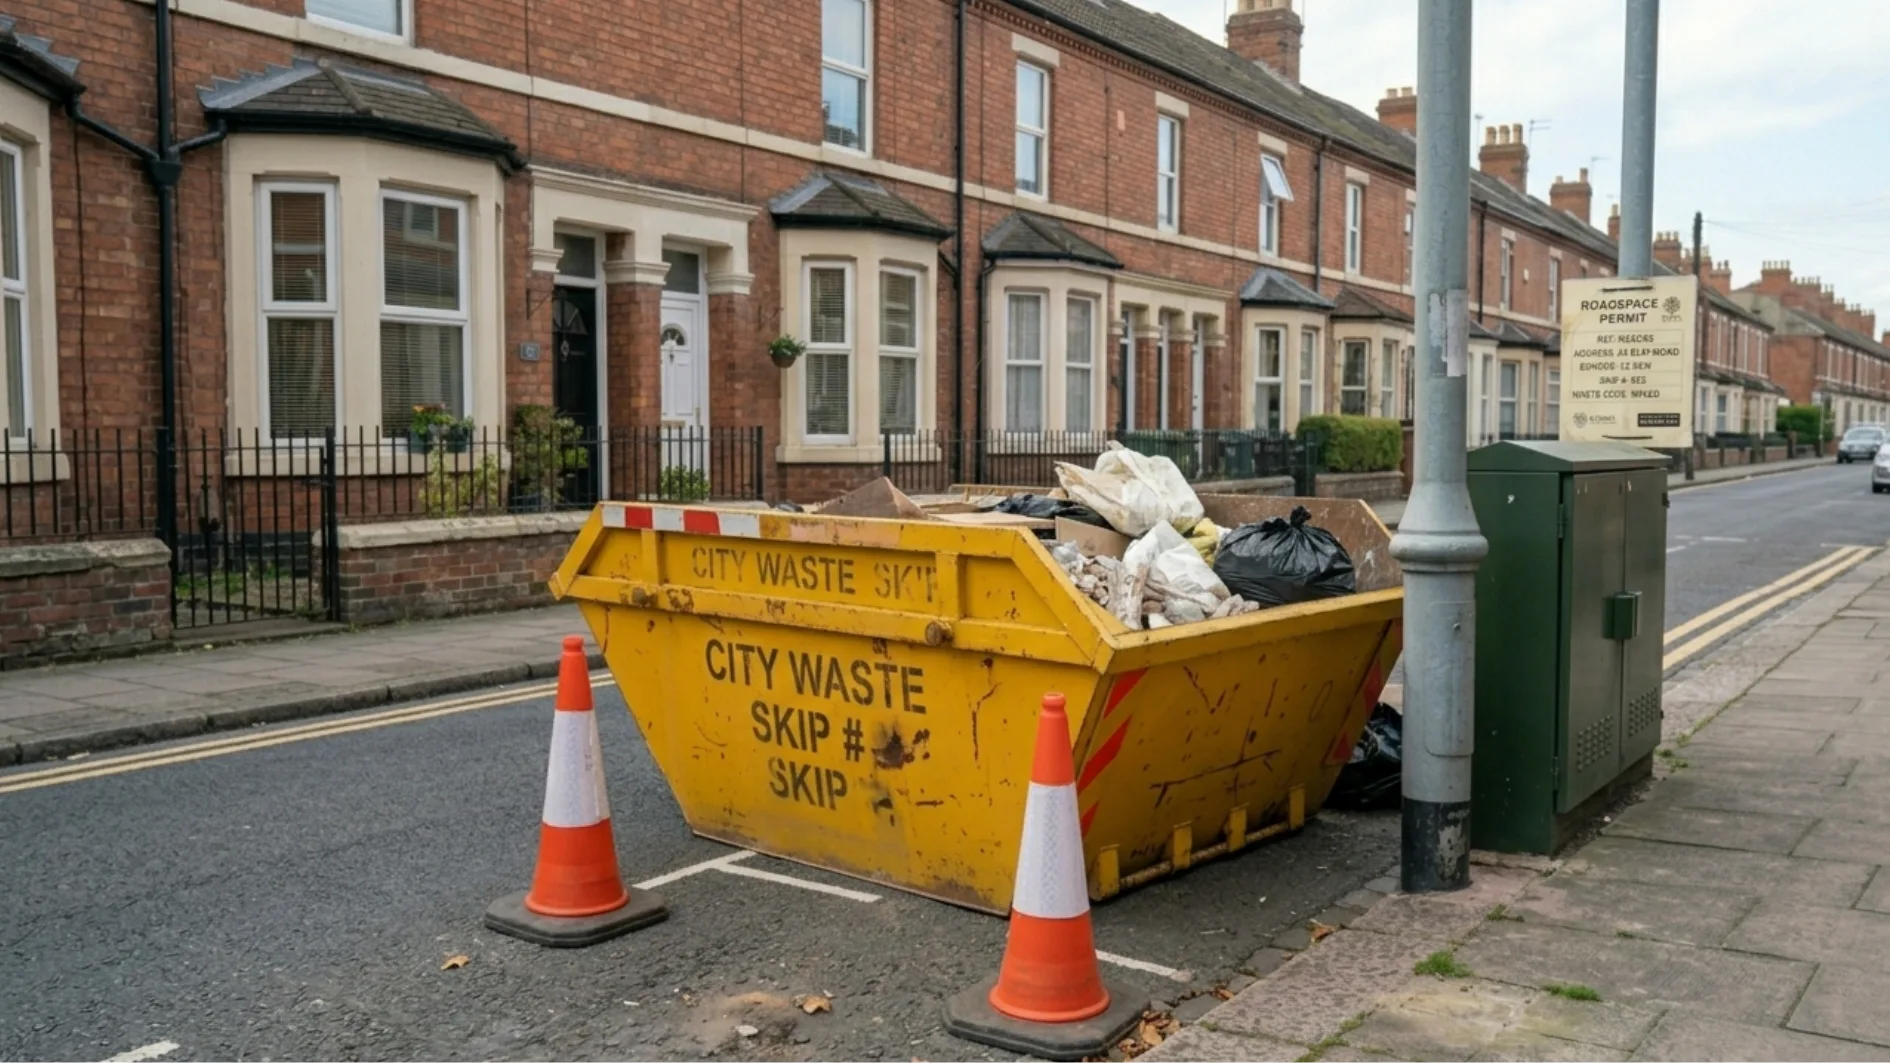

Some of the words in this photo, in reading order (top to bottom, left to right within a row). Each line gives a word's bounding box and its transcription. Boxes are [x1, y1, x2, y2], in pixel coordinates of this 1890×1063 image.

[1599, 312, 1647, 323] PERMIT
[692, 546, 747, 582] CITY
[756, 551, 856, 595] WASTE
[705, 638, 779, 691] CITY
[788, 650, 927, 715] WASTE
[751, 699, 830, 754] SKIP
[842, 717, 865, 763] #
[768, 756, 848, 811] SKIP
